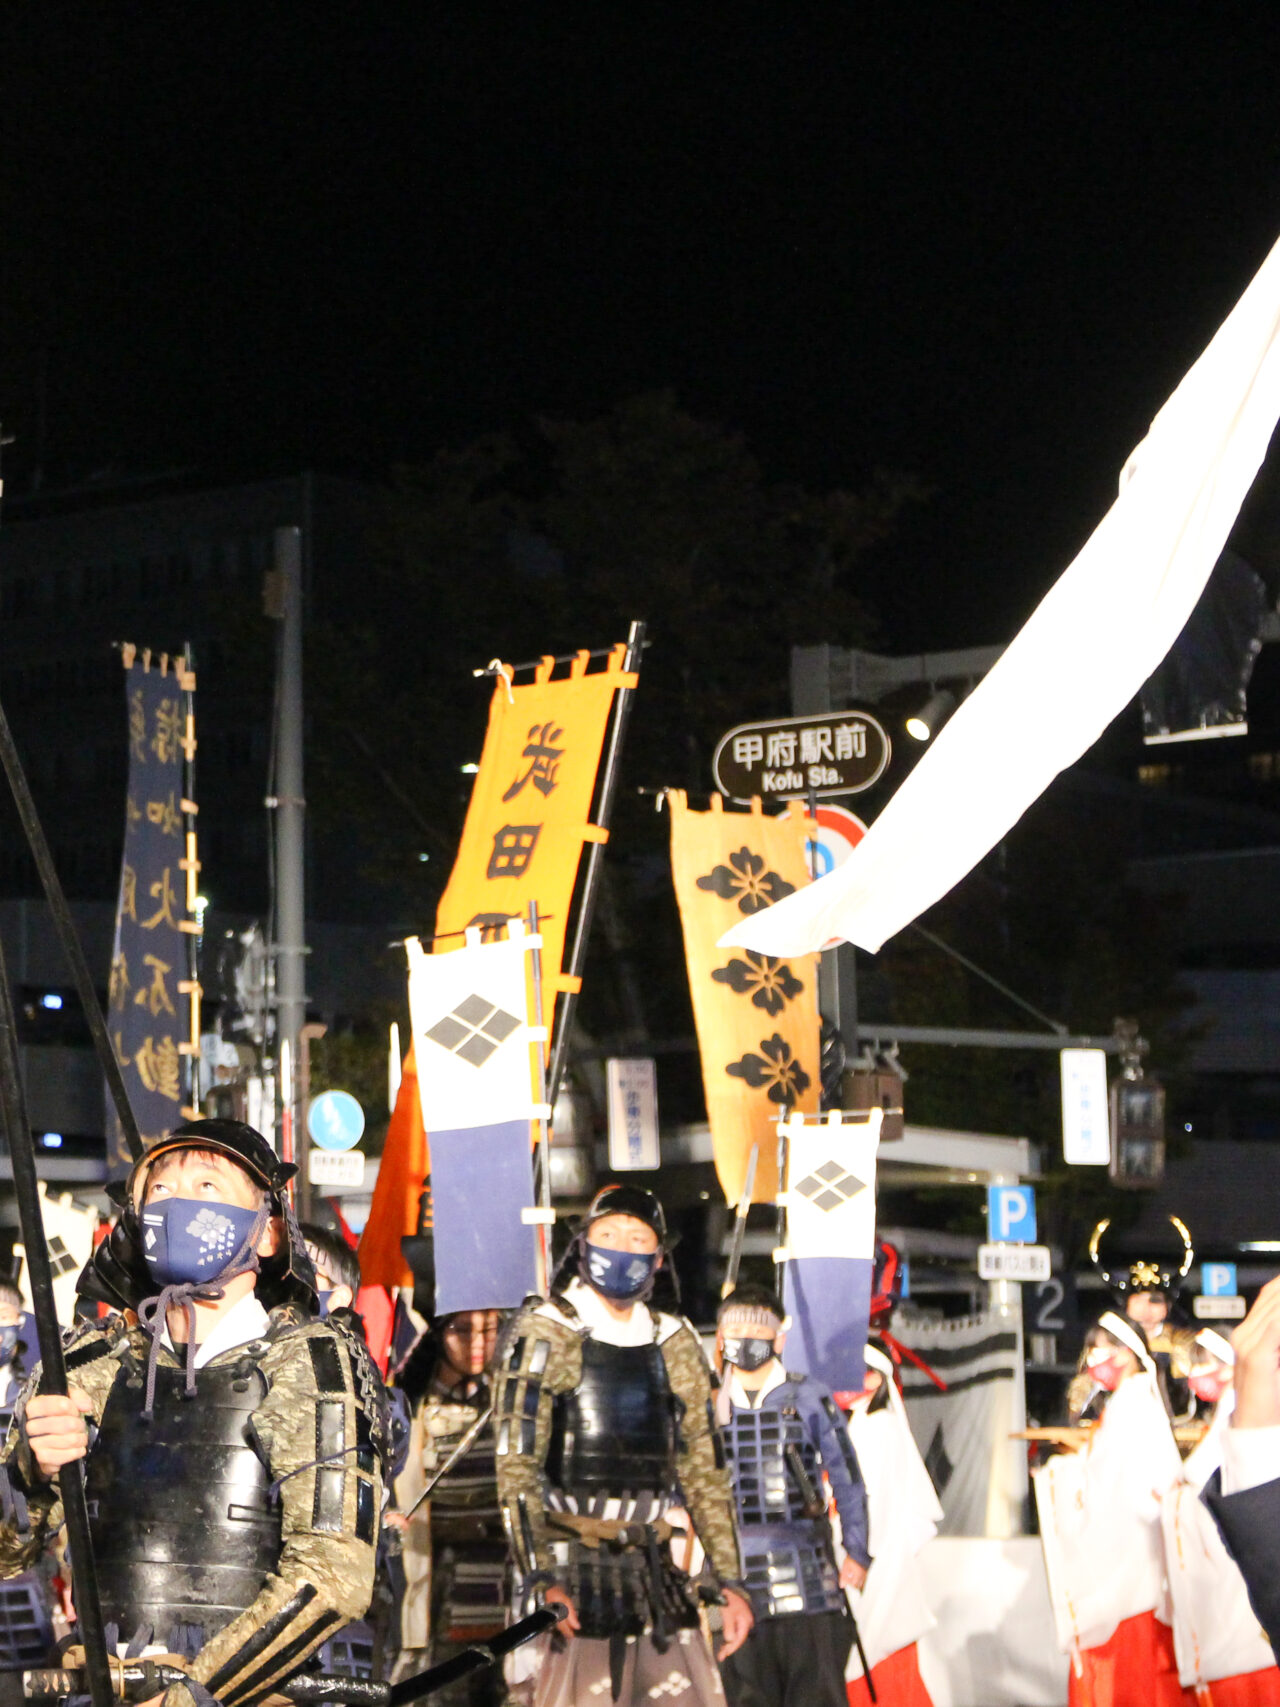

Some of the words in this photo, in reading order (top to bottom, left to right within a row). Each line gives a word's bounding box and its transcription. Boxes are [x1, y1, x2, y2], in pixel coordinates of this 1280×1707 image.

[732, 722, 868, 772] 甲府駅前
[761, 768, 804, 792] Kofu
[807, 765, 844, 788] Sta.
[999, 1190, 1028, 1238] P
[1035, 1277, 1066, 1330] 2
[1210, 1264, 1231, 1296] P
